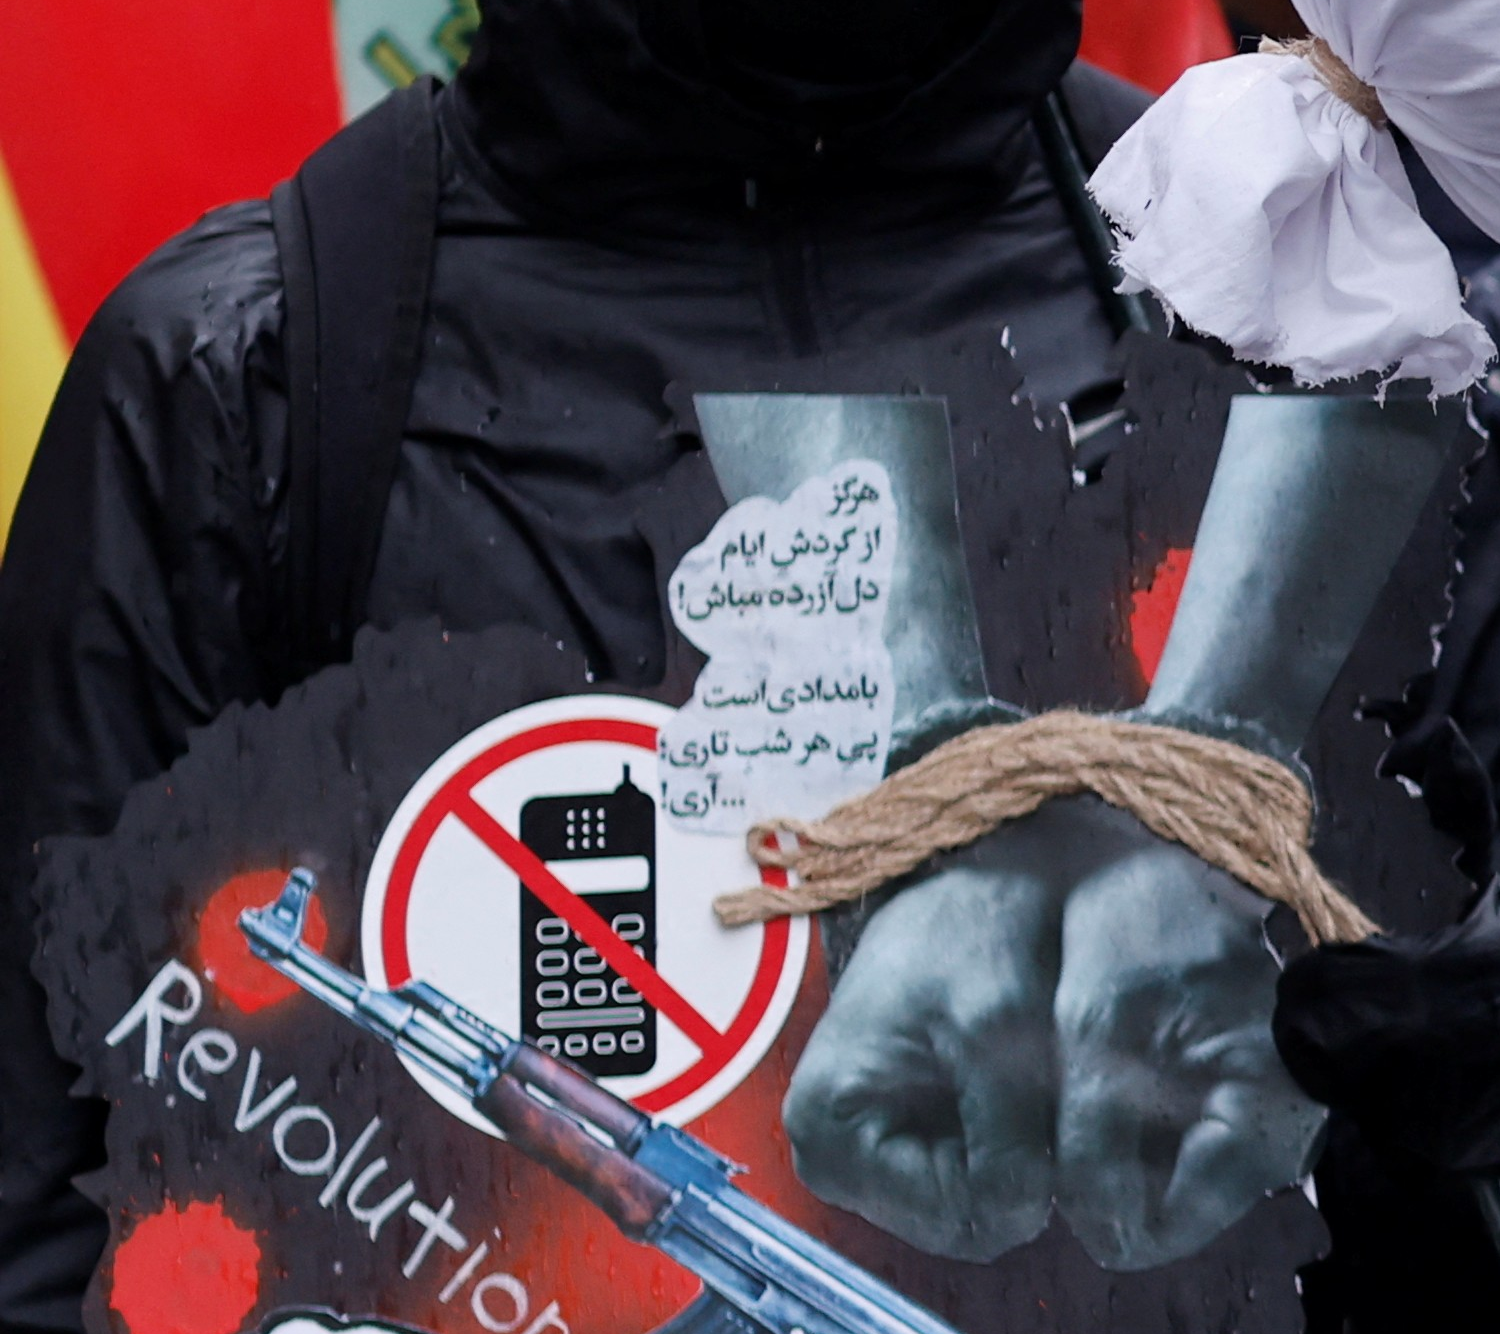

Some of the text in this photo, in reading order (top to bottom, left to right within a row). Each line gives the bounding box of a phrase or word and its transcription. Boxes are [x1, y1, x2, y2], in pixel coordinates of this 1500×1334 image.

[829, 475, 880, 516] هرگز
[720, 531, 765, 572] ایام
[859, 527, 881, 563] از
[678, 581, 763, 621] مباش!
[703, 678, 766, 708] است
[795, 731, 830, 766] هر
[837, 731, 878, 763] پی
